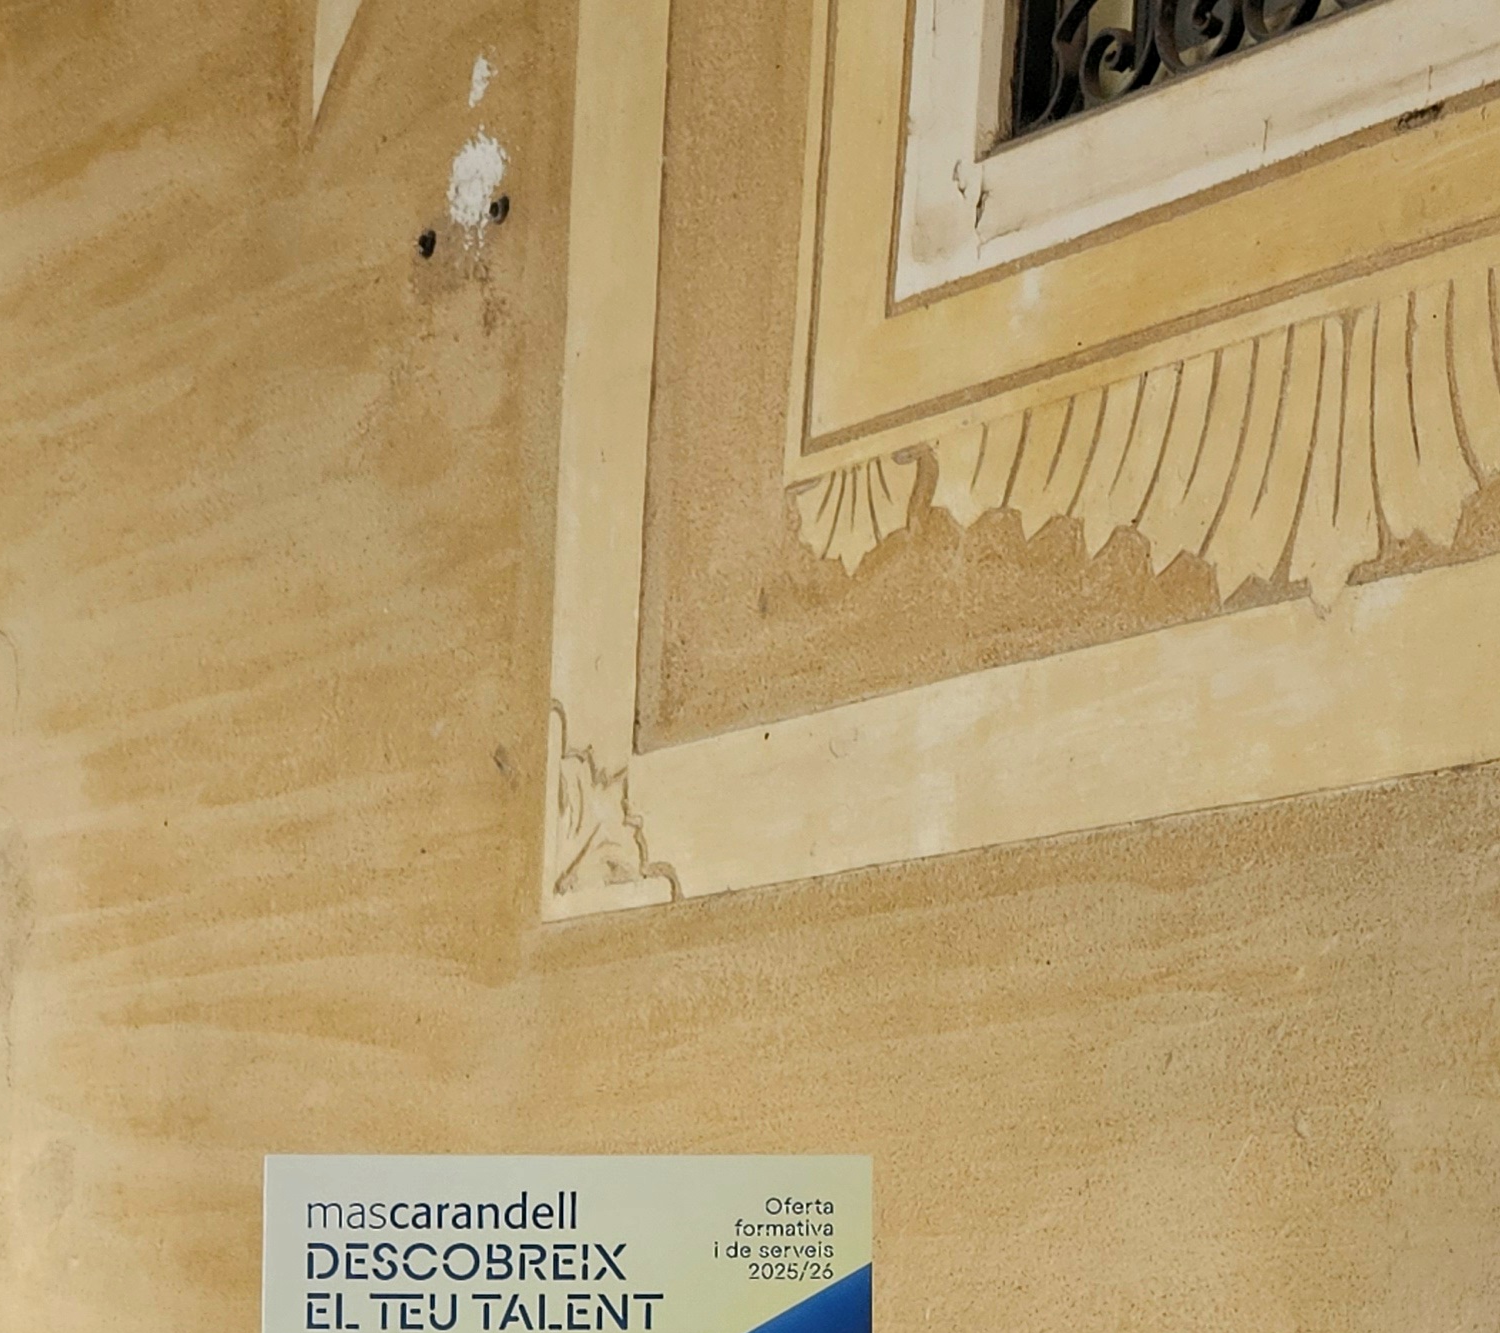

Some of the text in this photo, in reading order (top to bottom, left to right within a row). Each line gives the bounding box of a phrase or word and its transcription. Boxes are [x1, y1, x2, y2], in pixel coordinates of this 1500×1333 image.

[307, 1191, 577, 1229] mascarandell
[765, 1197, 834, 1215] Oferta
[735, 1218, 834, 1236] formativa
[714, 1241, 834, 1258] i de serveis
[307, 1242, 627, 1280] DESCOBREIX
[748, 1261, 834, 1281] 2025/26
[306, 1293, 664, 1330] EL TEU TALENT
